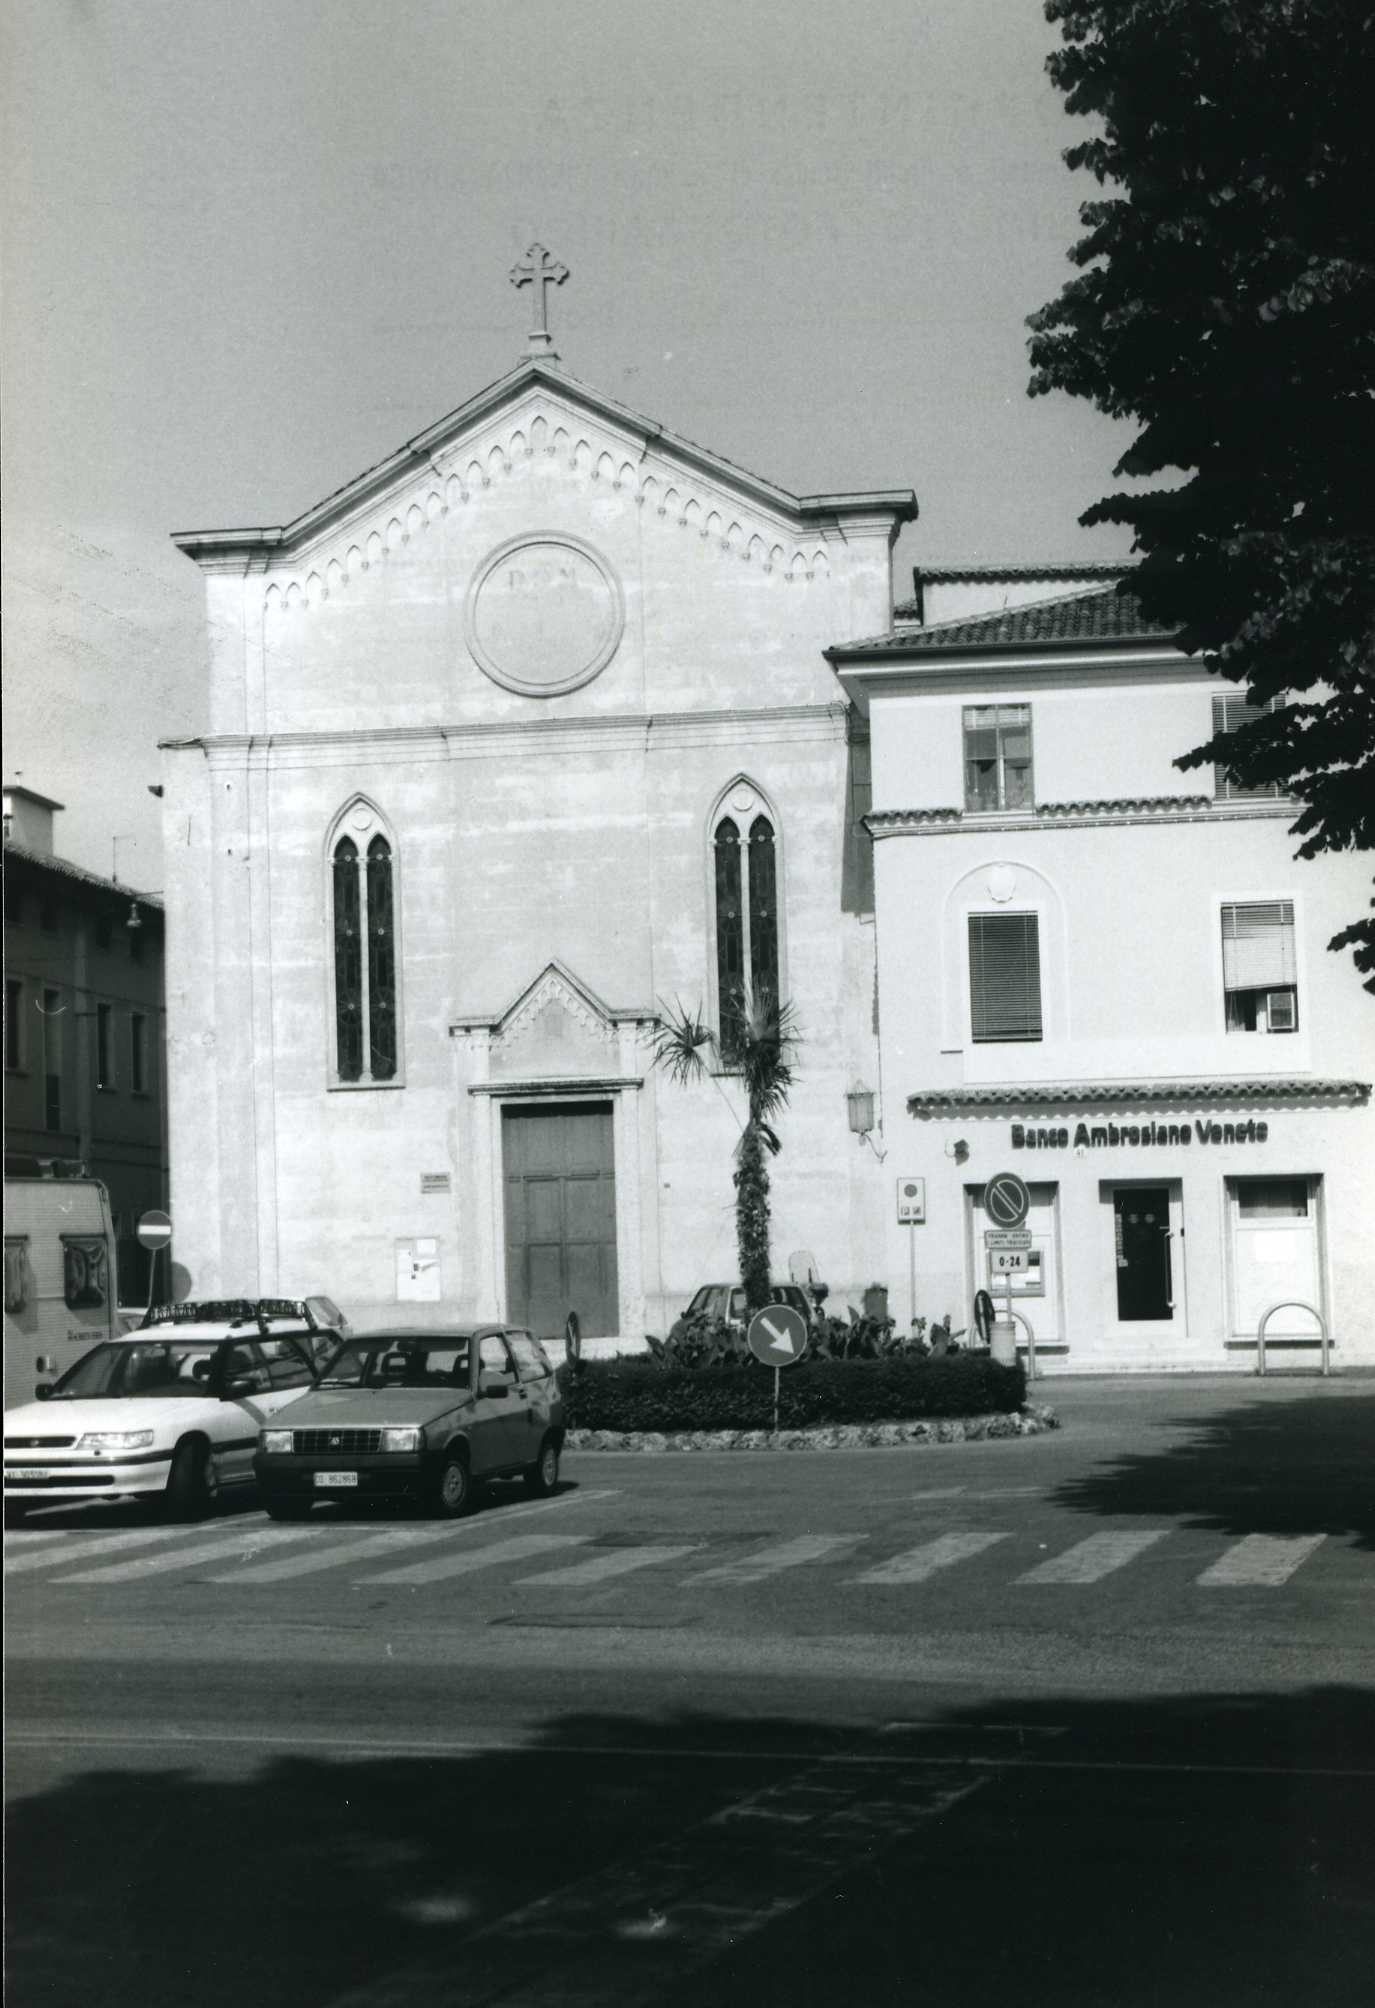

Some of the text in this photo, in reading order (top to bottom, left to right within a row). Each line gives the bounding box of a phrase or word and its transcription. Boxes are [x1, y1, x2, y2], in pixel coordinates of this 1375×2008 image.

[1011, 1118, 1268, 1149] Banco Ambrosiano Veneto
